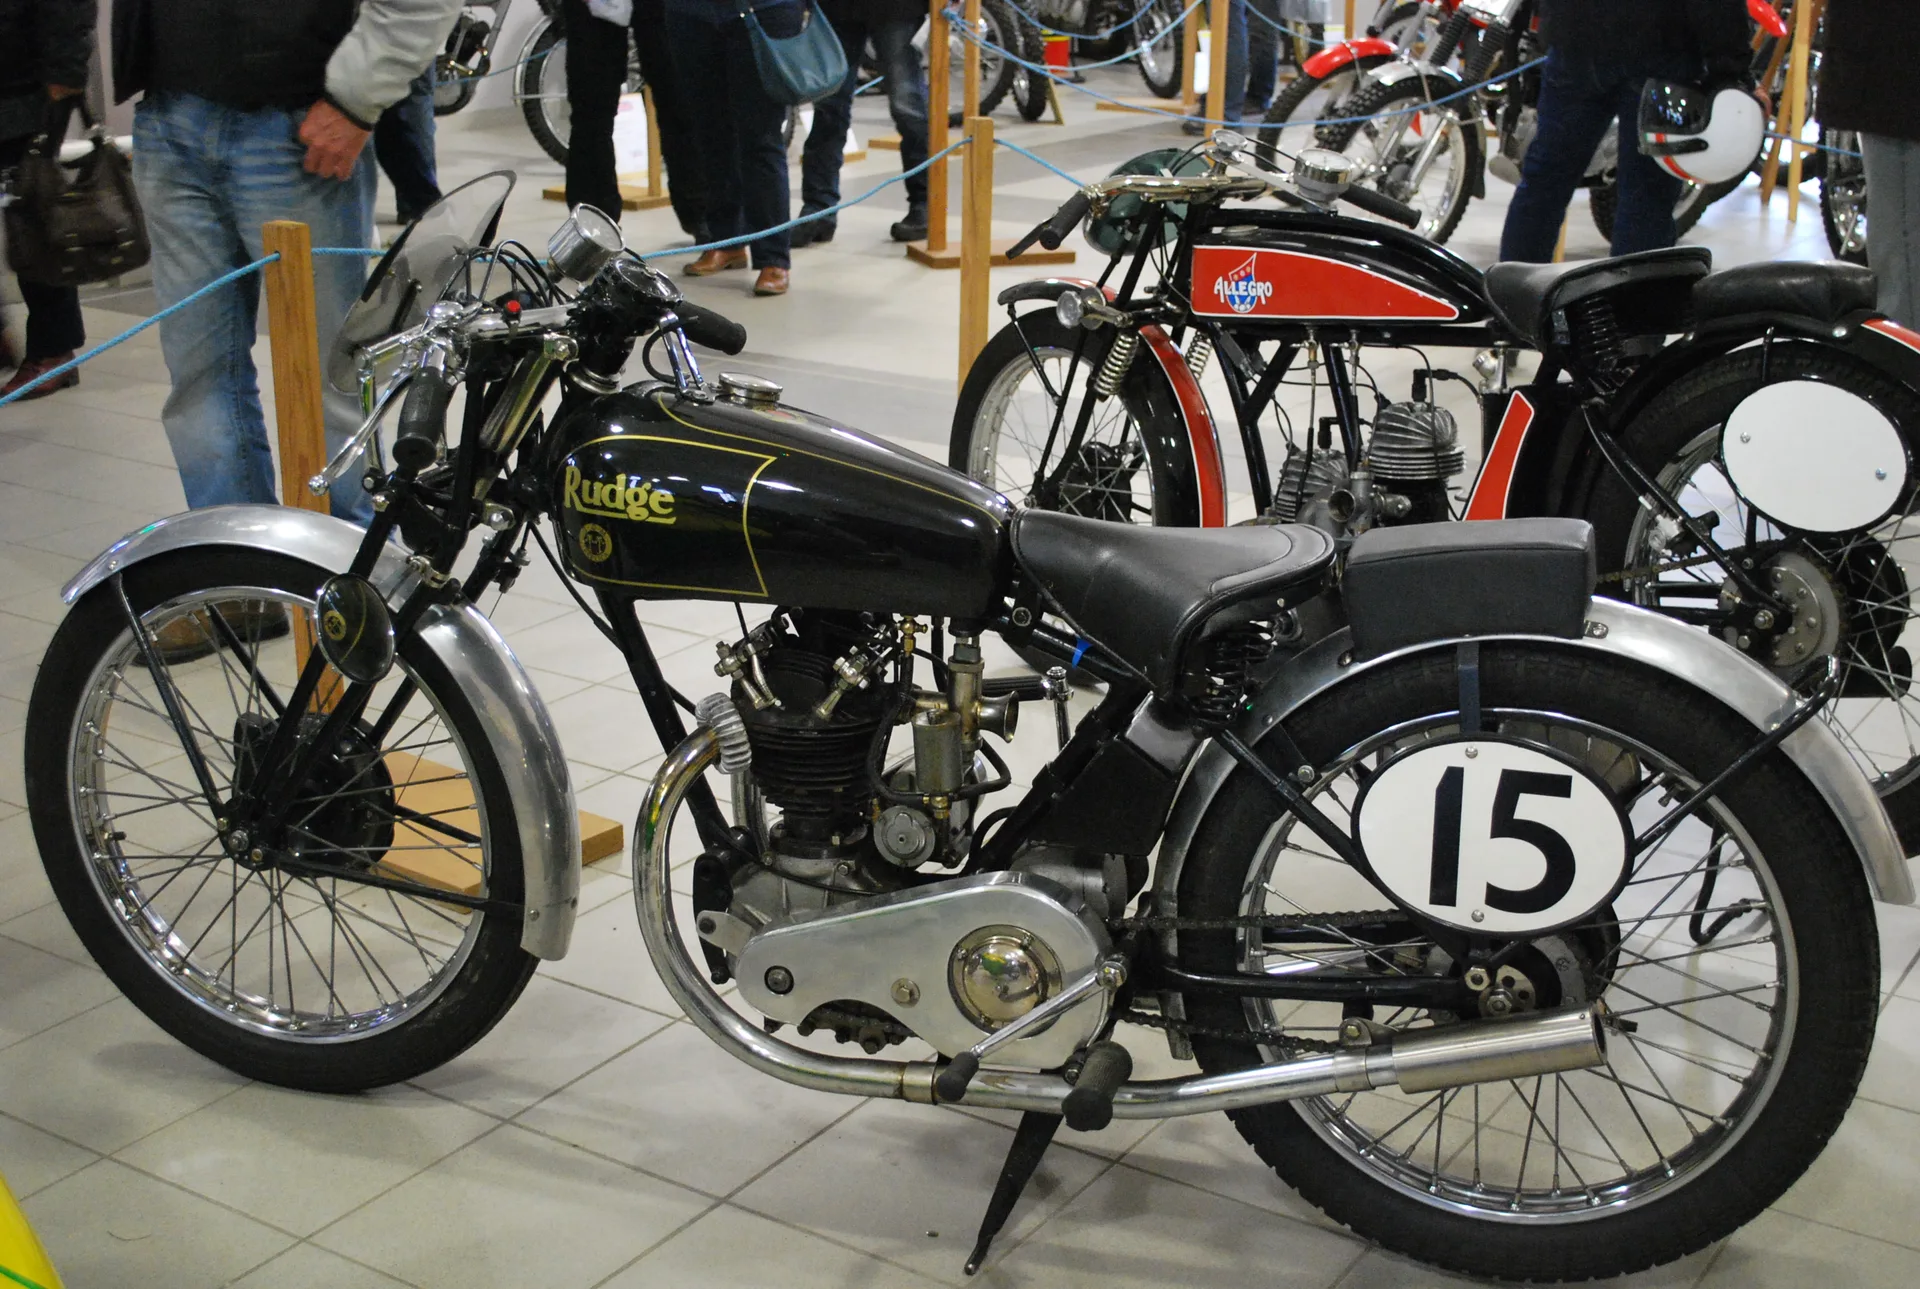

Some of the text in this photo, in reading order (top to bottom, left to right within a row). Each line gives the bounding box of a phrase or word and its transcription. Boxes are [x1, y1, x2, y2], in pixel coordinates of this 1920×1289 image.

[1213, 276, 1273, 305] ALLEGRO
[564, 466, 676, 524] Rudge
[1429, 766, 1576, 914] 15
